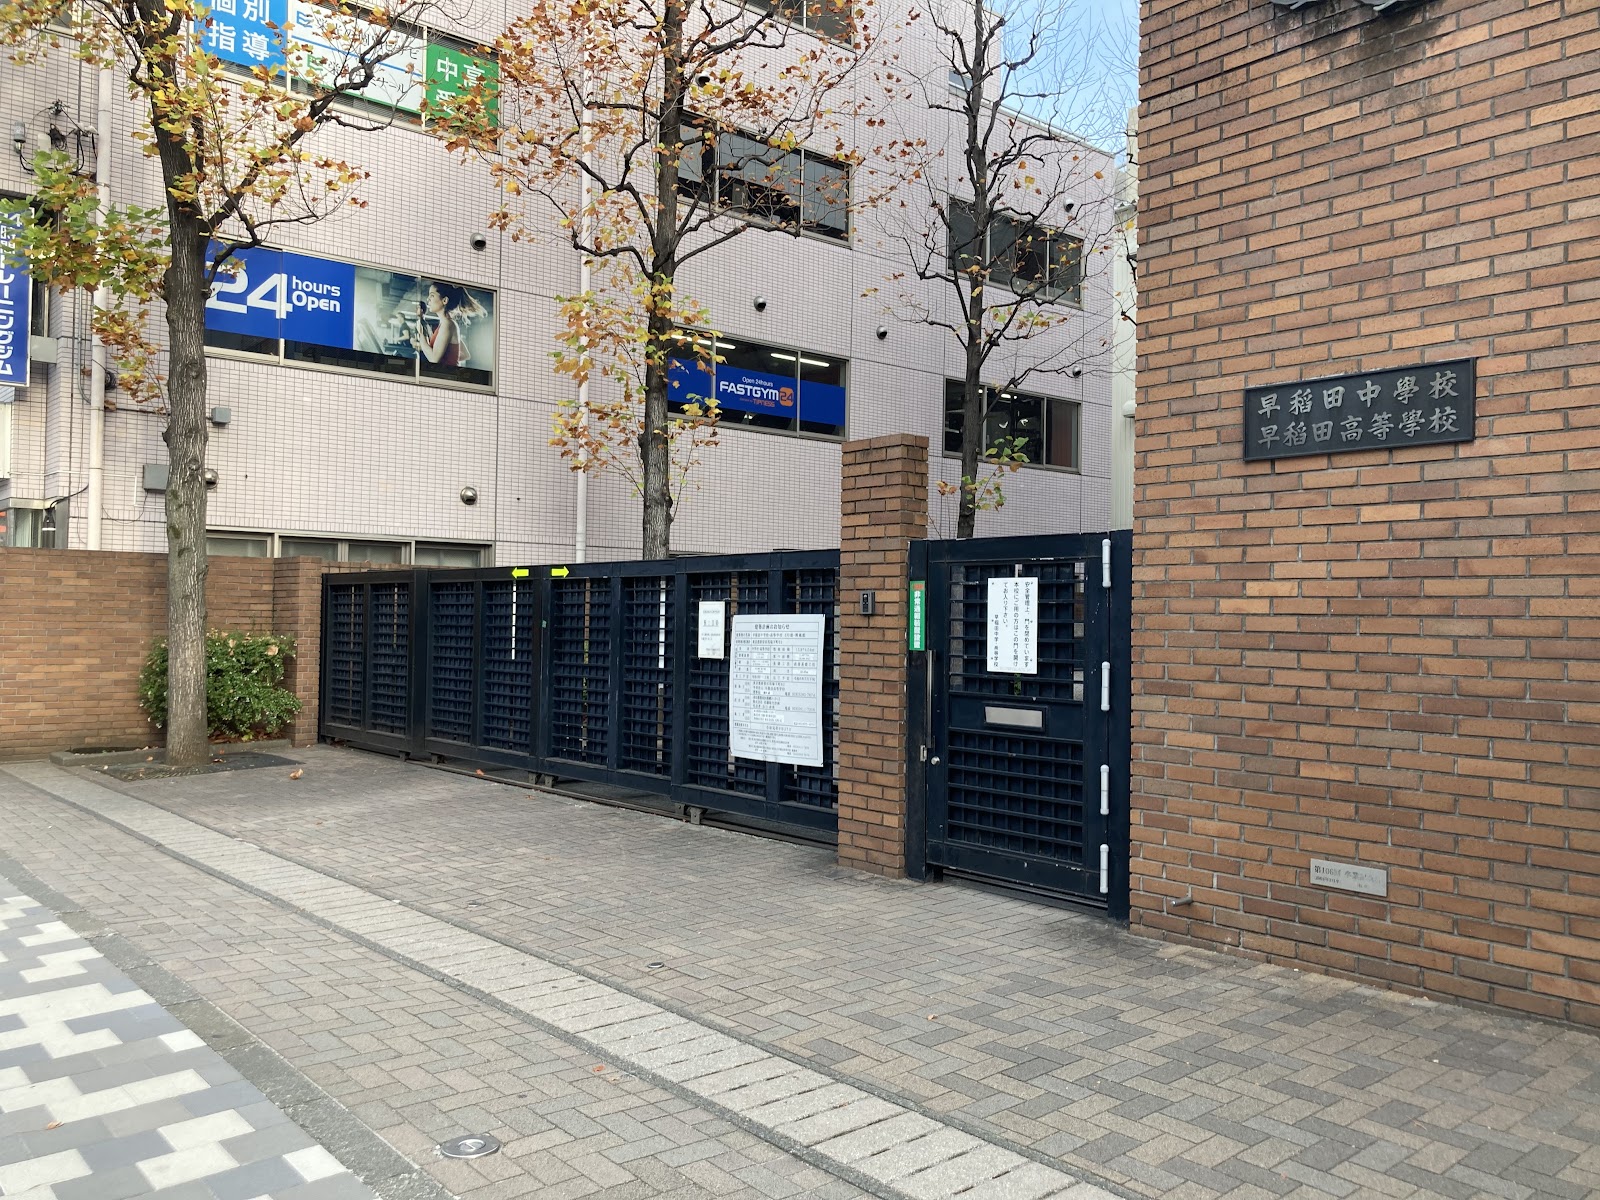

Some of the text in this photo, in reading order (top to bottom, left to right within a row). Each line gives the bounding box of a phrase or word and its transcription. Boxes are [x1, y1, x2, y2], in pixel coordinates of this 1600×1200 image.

[208, 20, 270, 61] 指導
[205, 261, 293, 319] 24
[292, 275, 341, 297] hours
[291, 290, 341, 313] Open
[719, 380, 779, 401] FASTGYM
[741, 376, 756, 386] Open
